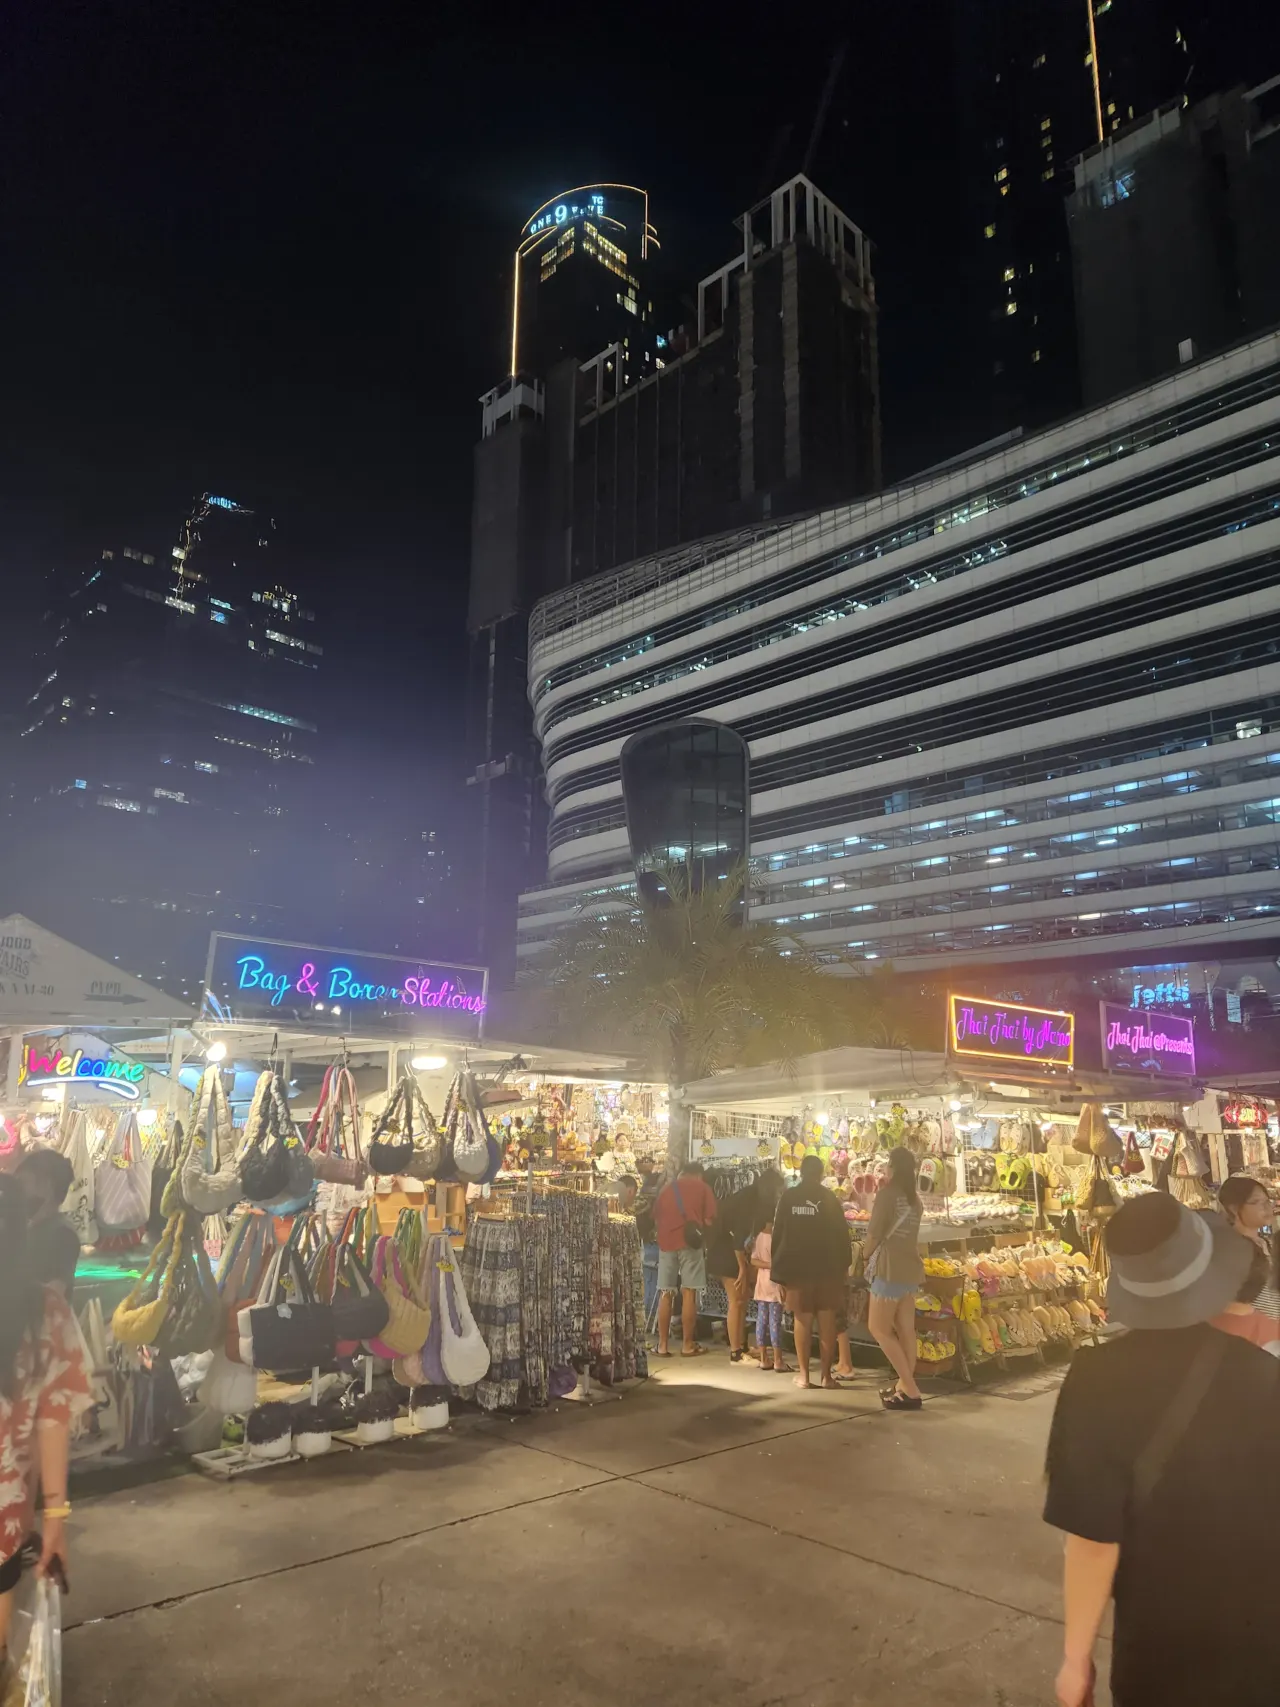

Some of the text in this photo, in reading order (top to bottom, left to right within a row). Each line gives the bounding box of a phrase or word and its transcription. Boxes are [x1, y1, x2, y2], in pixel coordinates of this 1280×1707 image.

[530, 214, 552, 234] ONE
[554, 204, 568, 225] 9
[236, 955, 291, 1007] Bag
[296, 962, 319, 997] &
[400, 976, 487, 1015] Stations
[956, 1007, 1071, 1054] Thai Thai by Nano
[1107, 1022, 1194, 1056] Thai Thai @Presents
[29, 1047, 145, 1082] Welcome
[791, 1206, 815, 1216] PUMA
